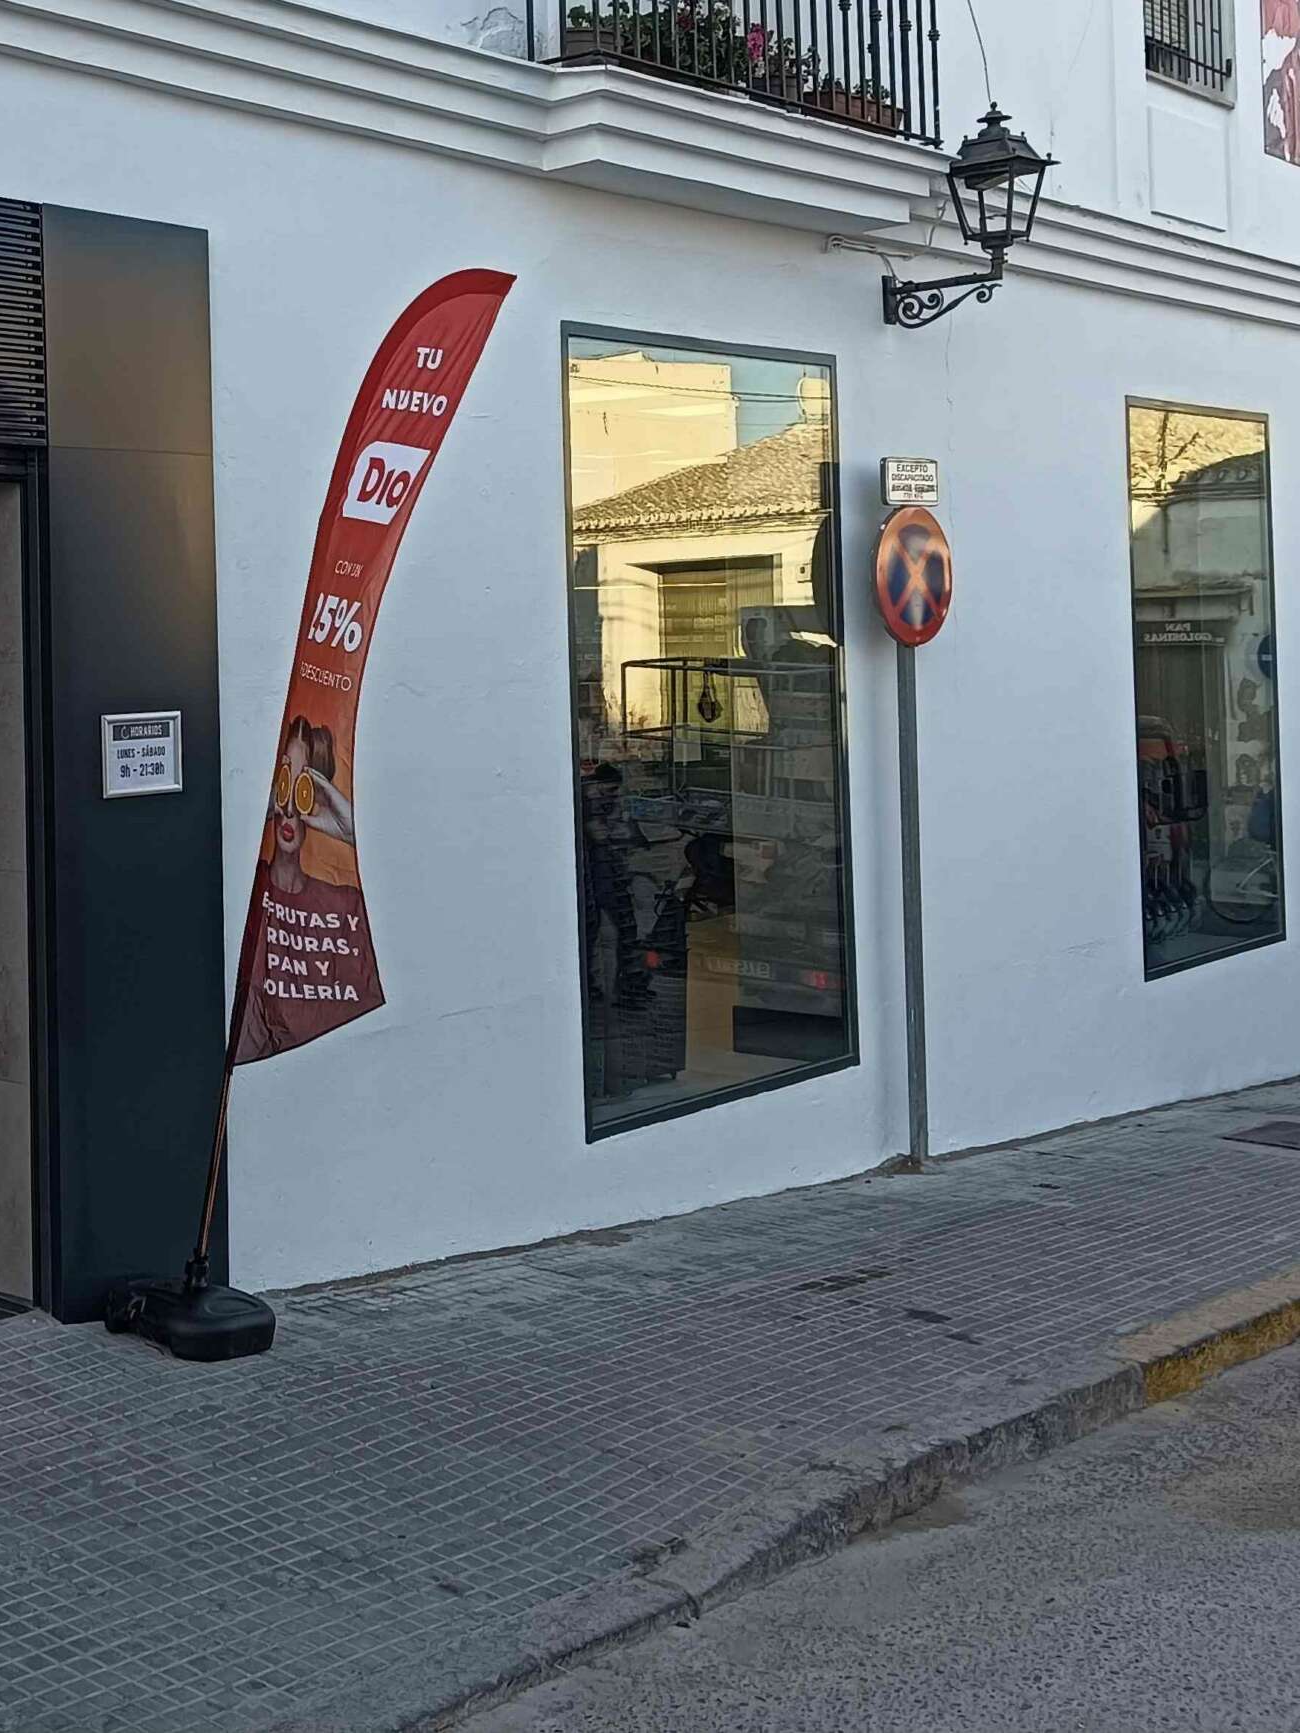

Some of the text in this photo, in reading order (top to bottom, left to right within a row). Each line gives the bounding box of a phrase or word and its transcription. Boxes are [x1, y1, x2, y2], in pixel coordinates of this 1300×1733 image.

[416, 347, 444, 370] TU
[381, 388, 448, 416] NUEVO
[896, 463, 928, 473] EXCEPTO
[130, 724, 162, 737] HORARIOS
[117, 748, 135, 759] LUNES
[141, 744, 166, 757] SÁBADO
[120, 764, 131, 778] 9h
[347, 914, 359, 931] Y
[267, 926, 359, 956] RDURAS,
[268, 953, 329, 976] PAN Y
[263, 978, 359, 1001] OLLERÍA
